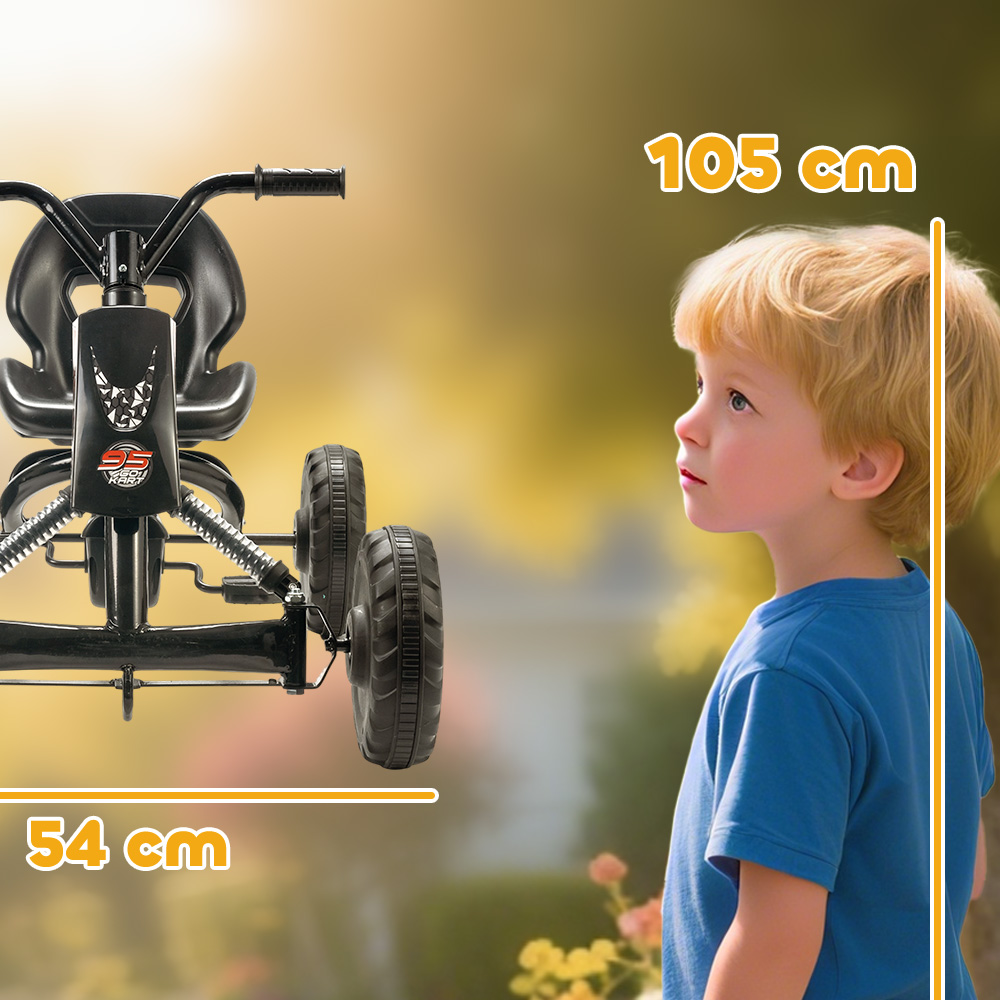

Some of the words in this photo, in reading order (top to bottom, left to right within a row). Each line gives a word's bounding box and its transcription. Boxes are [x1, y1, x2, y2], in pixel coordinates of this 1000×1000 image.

[97, 450, 153, 470] 95
[120, 469, 139, 477] GO
[108, 477, 144, 485] KART
